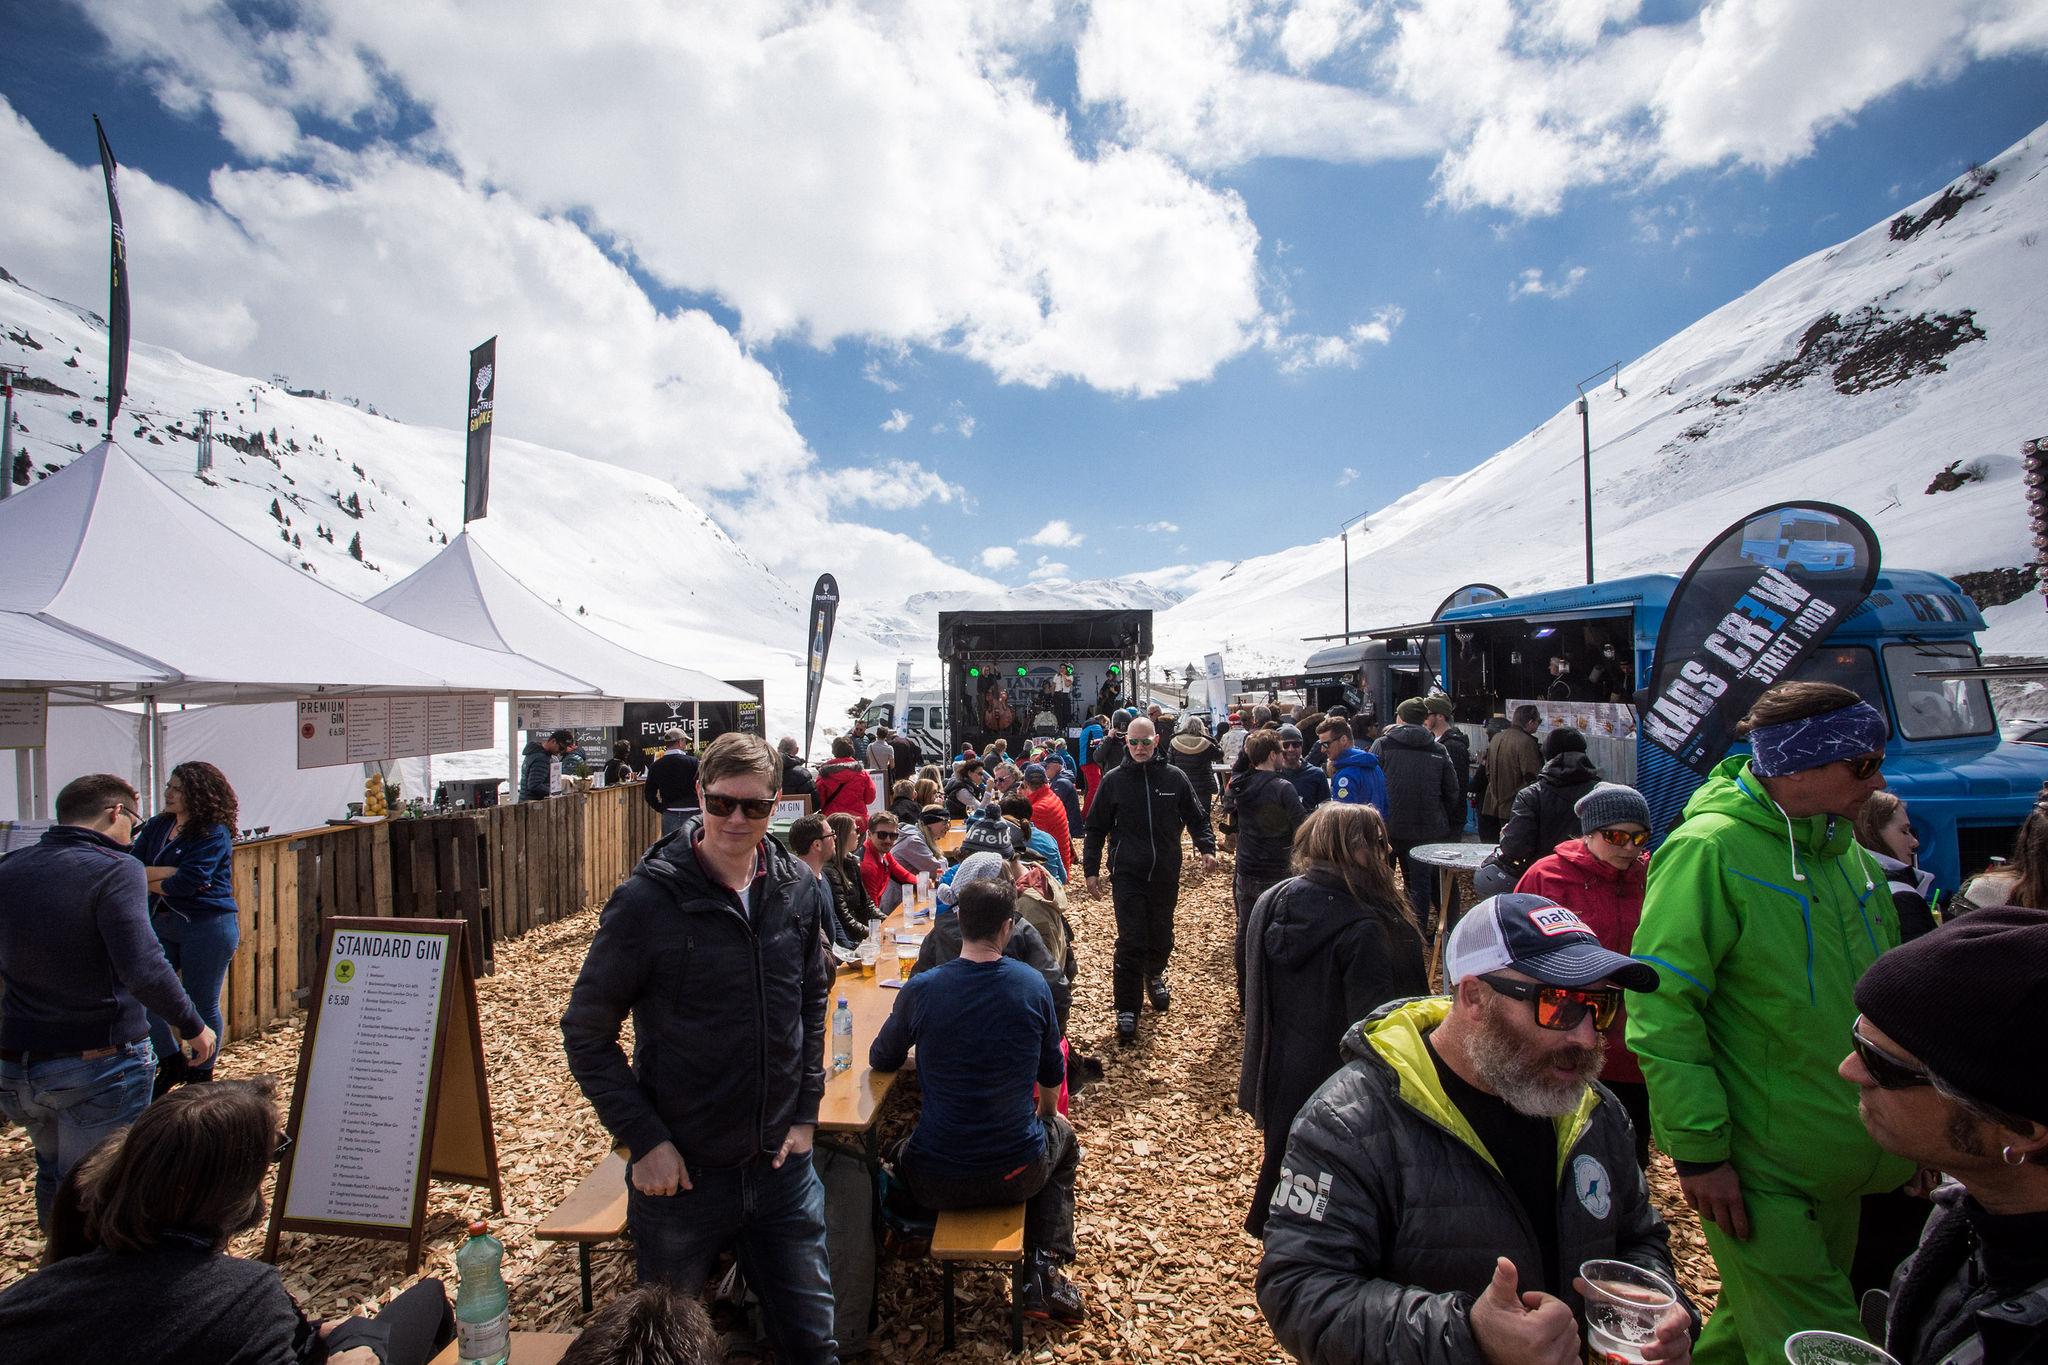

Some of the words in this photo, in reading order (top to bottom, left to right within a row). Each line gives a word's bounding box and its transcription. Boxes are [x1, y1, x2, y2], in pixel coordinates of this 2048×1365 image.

[1750, 632, 1803, 684] STREET
[1794, 598, 1836, 639] FOOD
[1643, 660, 1728, 751] KAOS
[1704, 568, 1811, 669] CREW
[301, 701, 344, 713] PREMIUM
[332, 713, 344, 723] GIN
[329, 728, 333, 736] €
[788, 803, 800, 812] GIN
[1537, 908, 1580, 925] nativ
[336, 936, 411, 958] STANDARD
[416, 940, 441, 960] GIN
[328, 994, 333, 1004] €
[334, 994, 349, 1005] 5,50
